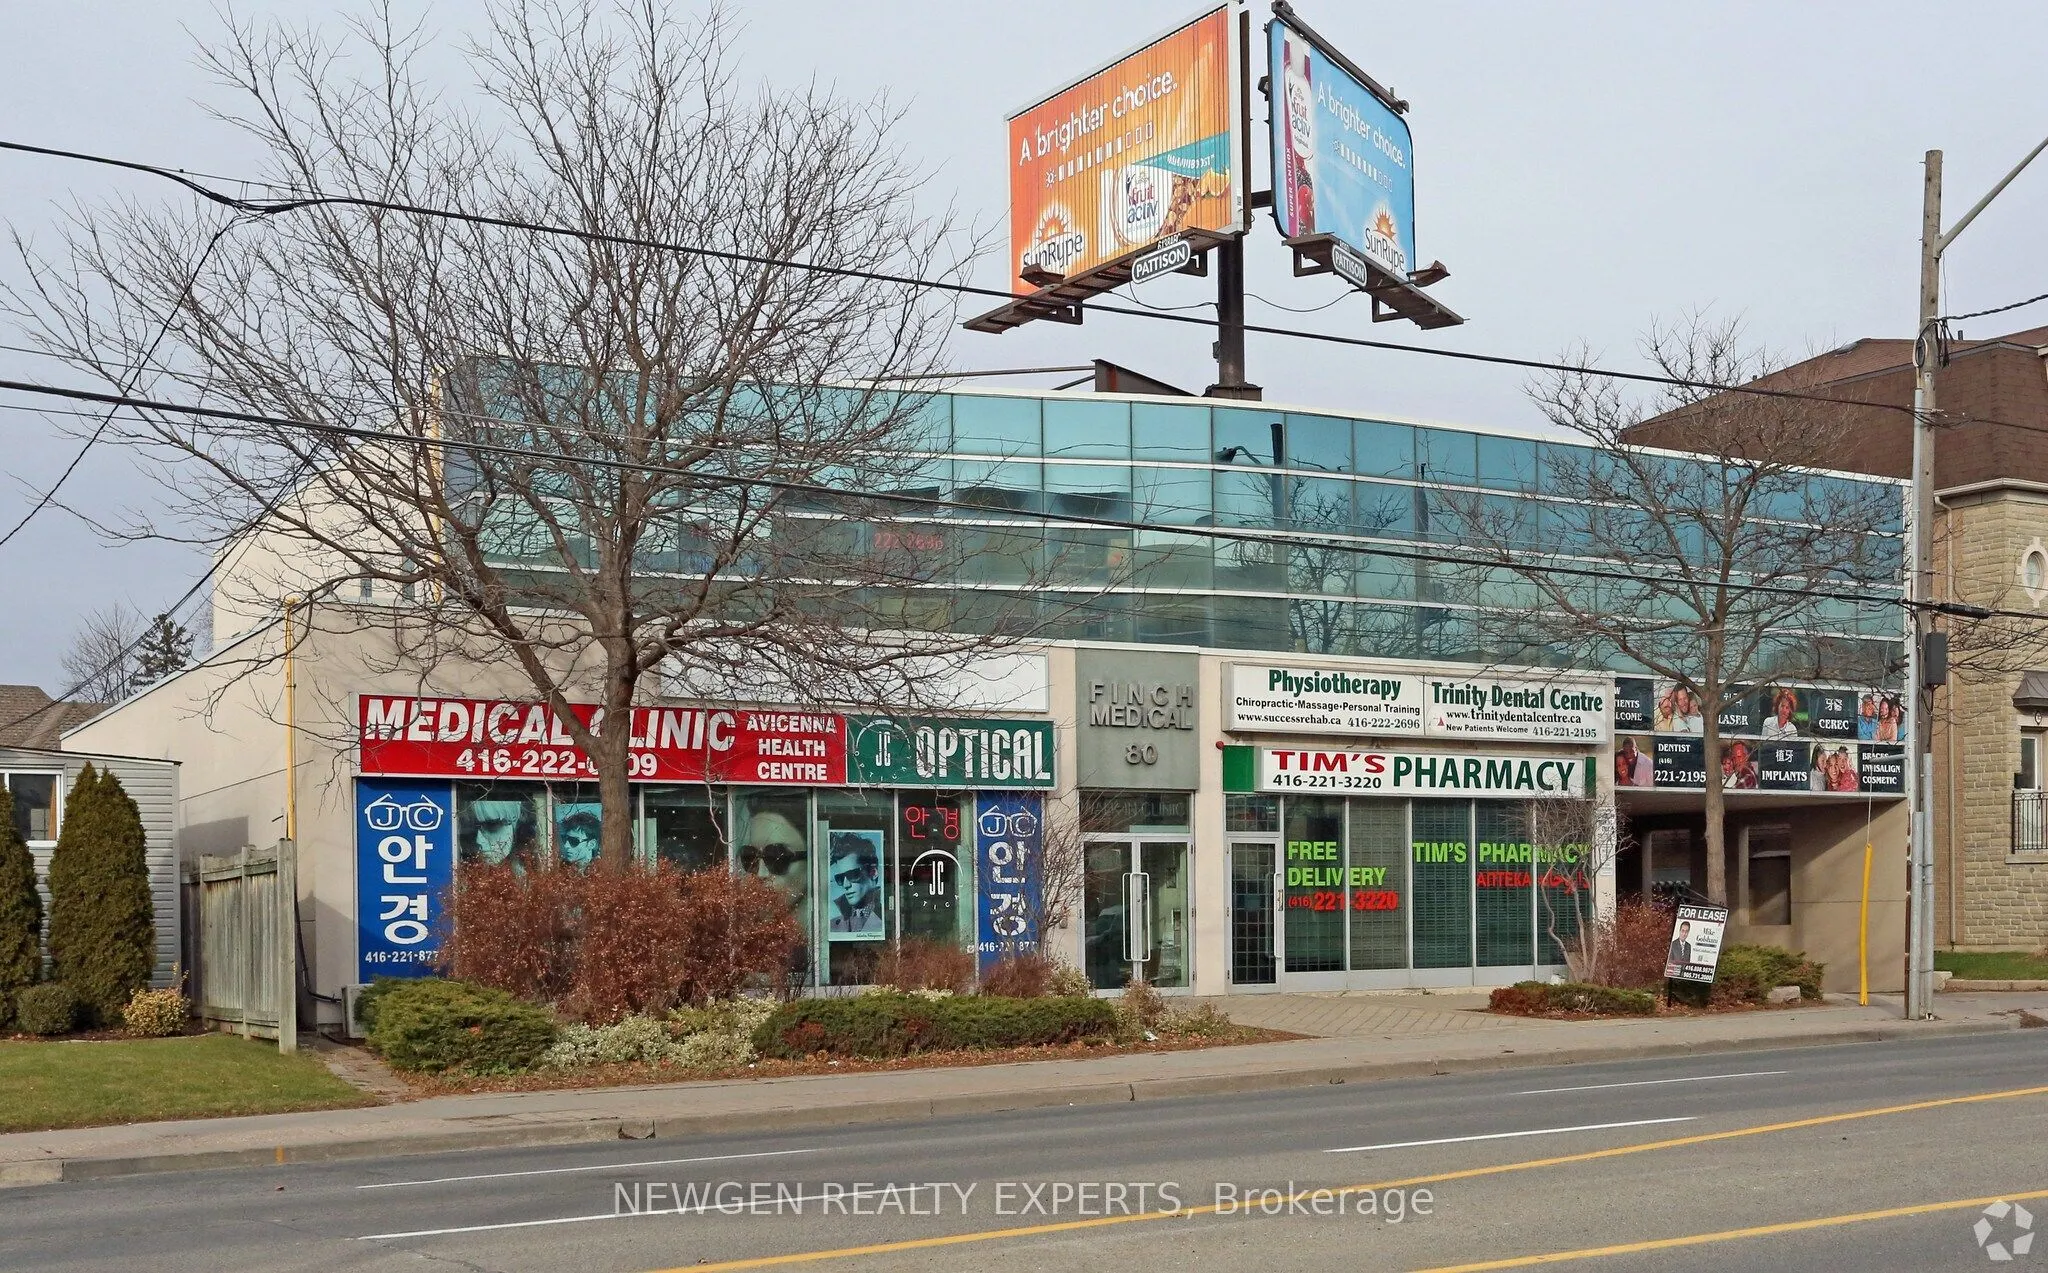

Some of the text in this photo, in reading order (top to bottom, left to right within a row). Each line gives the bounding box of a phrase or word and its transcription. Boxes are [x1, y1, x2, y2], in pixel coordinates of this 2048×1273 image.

[1019, 71, 1178, 166] A brighter choice.
[1318, 82, 1406, 169] A brighter choice.
[1131, 183, 1154, 205] fruit
[1365, 227, 1405, 274] SunRype
[1136, 250, 1186, 278] PATTISON
[1335, 249, 1365, 282] PATTISON
[1089, 680, 1193, 707] FINCH
[1269, 669, 1402, 701] Physiotherapy
[1431, 682, 1603, 711] Trinity Dental Centre
[1089, 705, 1193, 730] MEDICAL
[1384, 704, 1420, 716] Training
[1446, 708, 1581, 725] www.trinitydentalcentre.ca
[1718, 714, 1749, 725] LASER
[364, 698, 575, 746] MEDICAL
[747, 713, 838, 734] AVICENNA
[1238, 713, 1420, 729] www.successrehab.ca 416-222-2696
[1464, 724, 1494, 732] Patients
[1532, 726, 1597, 738] 416-221-2195
[1818, 719, 1849, 730] CEREC
[758, 738, 826, 757] HEALTH
[916, 725, 1051, 780] OPTICAL
[1125, 742, 1158, 765] 80
[1658, 743, 1691, 753] DENTIST
[456, 748, 658, 776] 416-222-09
[757, 762, 828, 781] CENTRE
[1271, 751, 1575, 791] TIM'S PHARMACY
[1862, 764, 1901, 773] INVISALIGN
[1272, 774, 1382, 789] 416-221-3220
[1654, 770, 1707, 783] 221-2195
[1762, 770, 1808, 782] IMPLANTS
[1862, 775, 1898, 785] COSMETIC
[905, 806, 961, 839] 안경
[1288, 841, 1337, 860] FREE
[1412, 842, 1467, 864] TIM'S
[1479, 842, 1592, 864] PHARMACY
[929, 860, 944, 896] JC
[1288, 867, 1387, 887] DELIVERY
[377, 835, 434, 945] 안경
[1288, 891, 1399, 911] (416) 221-3220
[1678, 907, 1726, 921] FOR LEASE
